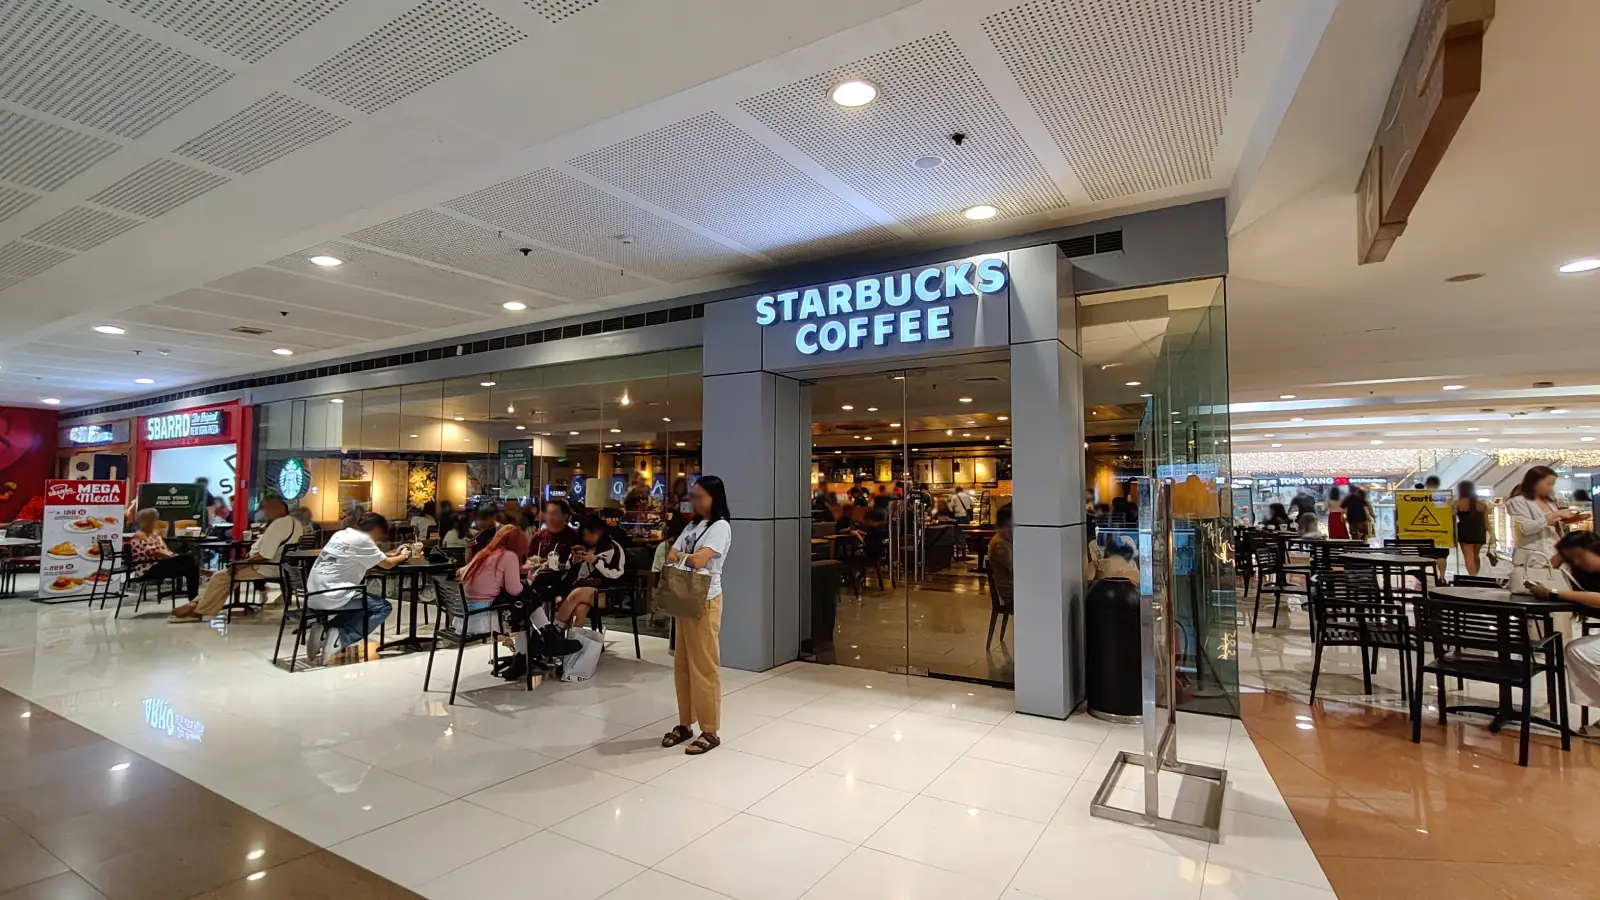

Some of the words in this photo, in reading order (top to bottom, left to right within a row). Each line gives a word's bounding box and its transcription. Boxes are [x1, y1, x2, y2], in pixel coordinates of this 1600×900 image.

[756, 258, 1007, 326] STARBUCKS
[795, 306, 951, 355] COFFEE
[147, 413, 190, 440] SBARRO
[1279, 477, 1306, 487] TONG
[1306, 477, 1334, 486] YANG
[78, 484, 120, 494] MEGA
[76, 492, 120, 503] Meals
[1403, 494, 1448, 502] Cauti
